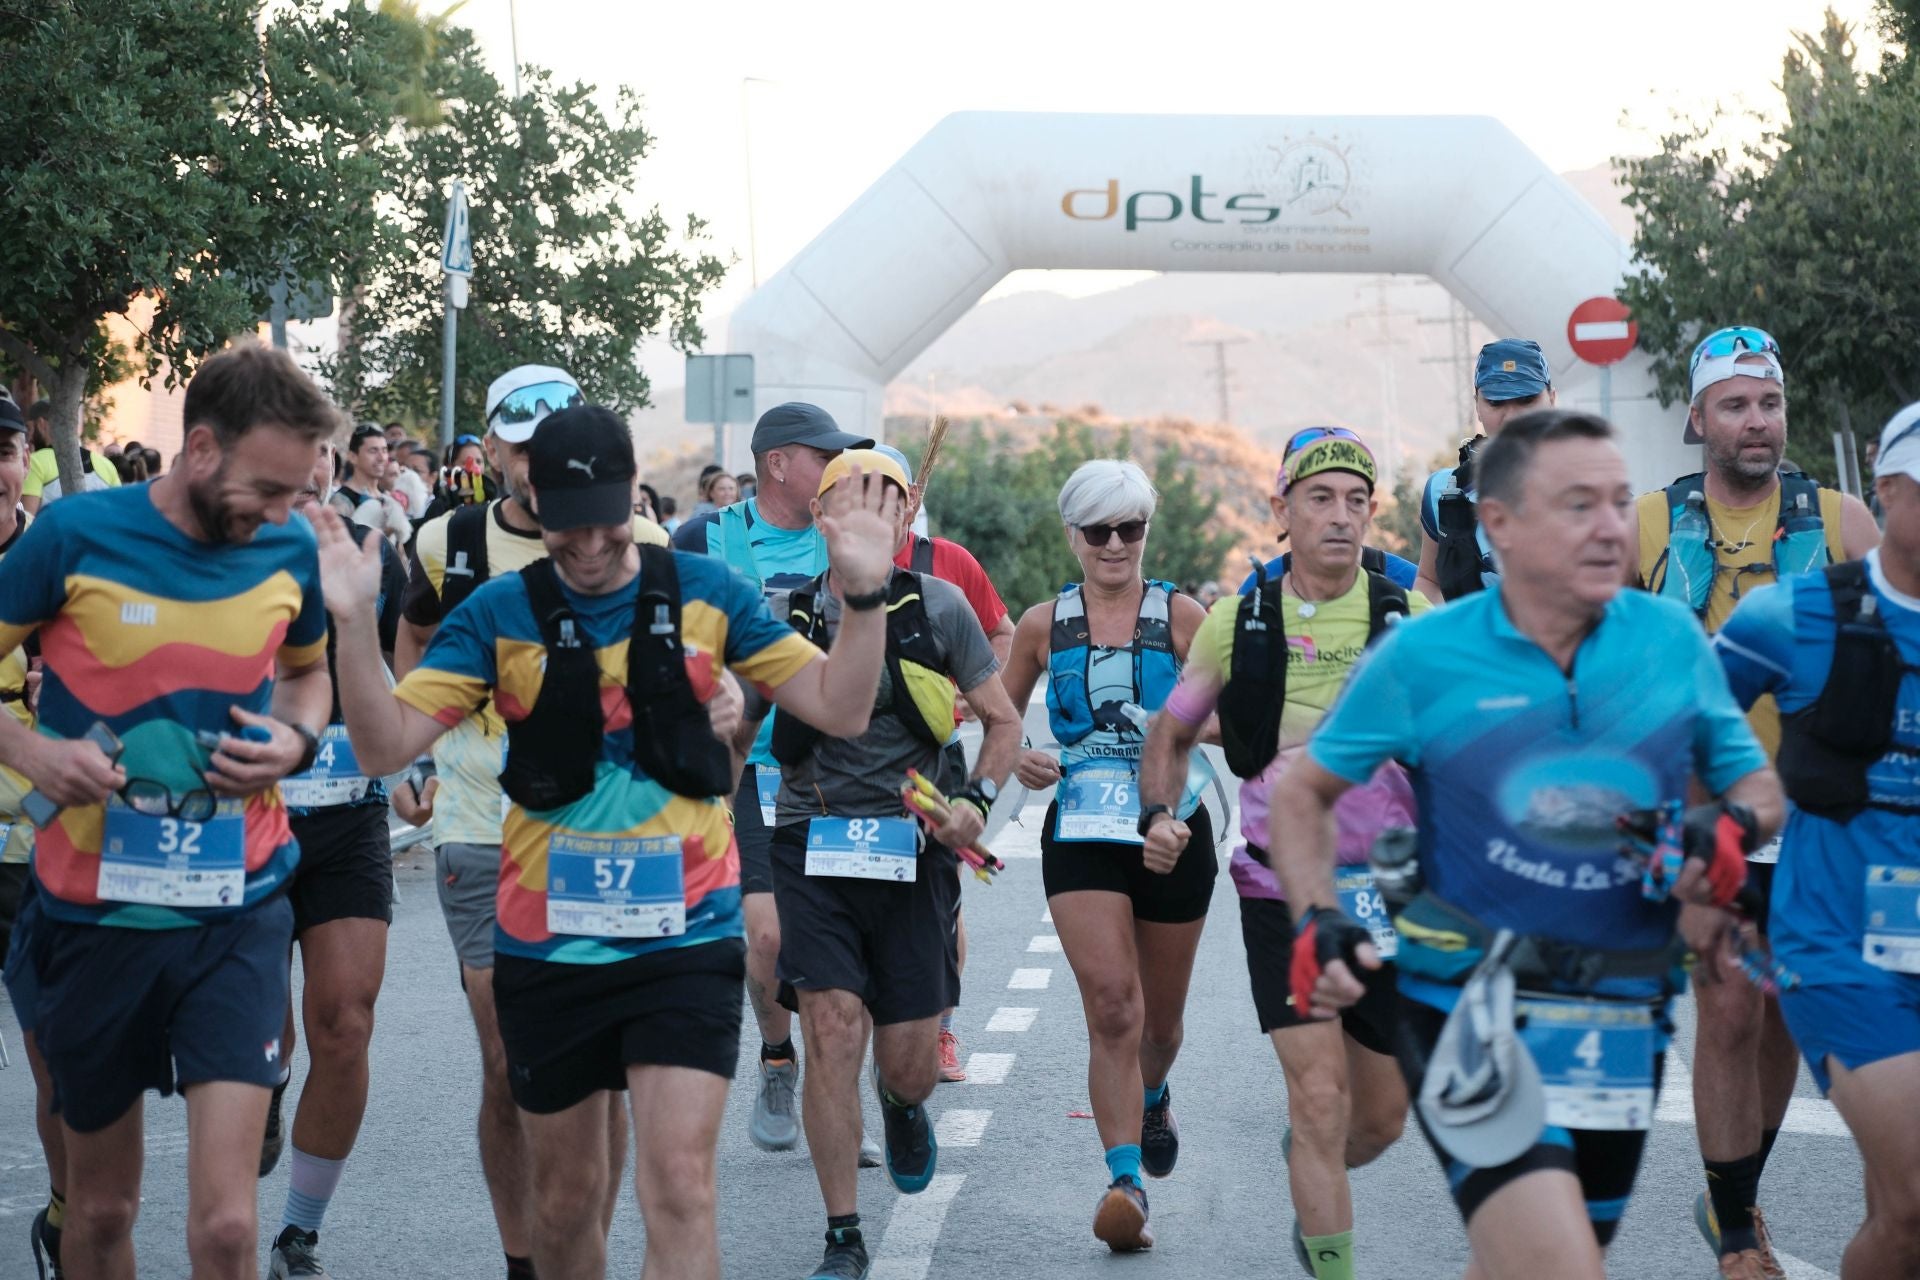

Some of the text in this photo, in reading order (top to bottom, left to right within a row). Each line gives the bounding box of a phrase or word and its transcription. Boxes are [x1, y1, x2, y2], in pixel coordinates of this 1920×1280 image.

[1061, 174, 1280, 231] dpts
[1268, 239, 1291, 252] de
[1296, 239, 1371, 254] Deportes
[1141, 640, 1167, 649] EVADICT
[1103, 747, 1143, 757] CARRA
[1099, 783, 1129, 805] 76
[158, 817, 203, 855] 32
[847, 818, 880, 842] 82
[594, 858, 636, 890] 57
[1487, 839, 1566, 888] Venta
[1571, 862, 1611, 891] La
[1355, 891, 1387, 918] 84
[1573, 1030, 1603, 1068] 4
